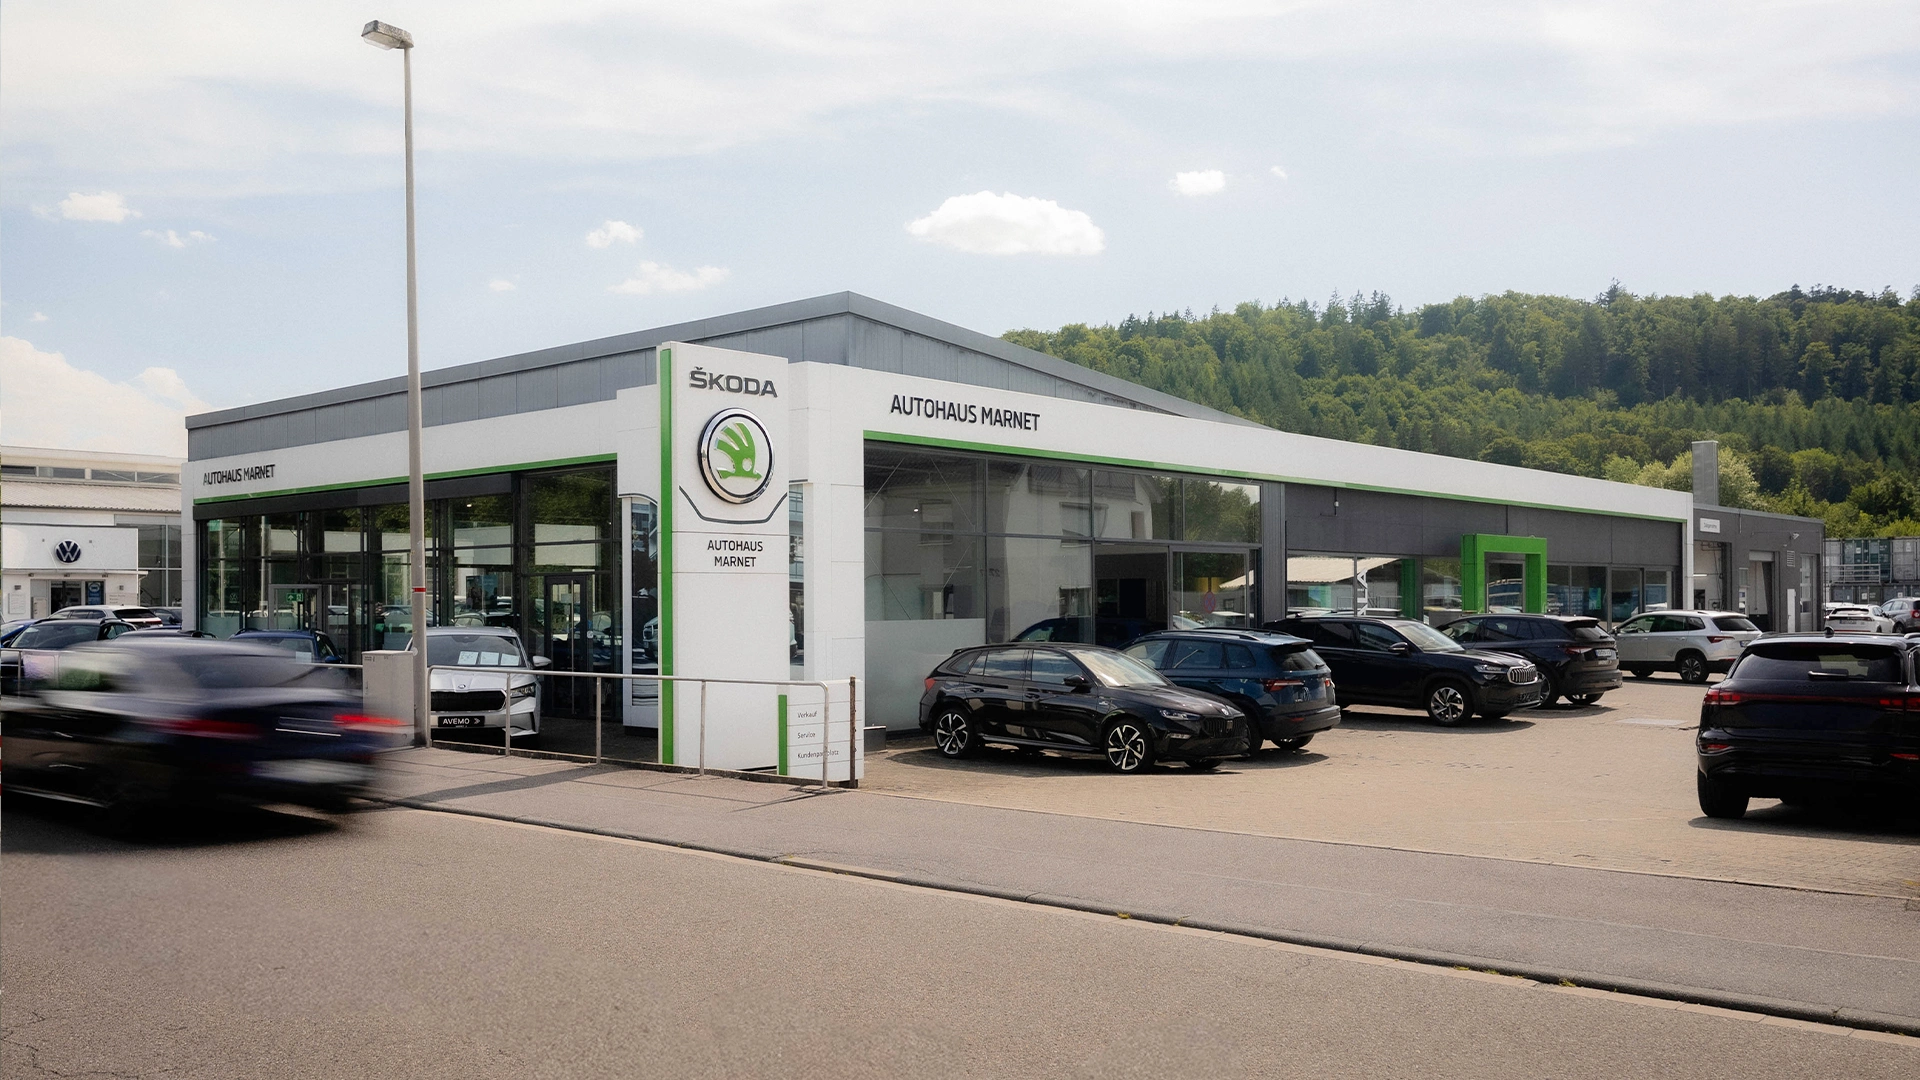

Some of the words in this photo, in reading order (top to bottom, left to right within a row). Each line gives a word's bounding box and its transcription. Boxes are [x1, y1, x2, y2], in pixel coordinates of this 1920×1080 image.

[689, 366, 778, 398] ŠKODA
[890, 394, 977, 423] AUTOHAUS
[981, 406, 1041, 431] MARNET
[203, 468, 242, 485] AUTOHAUS
[243, 464, 275, 481] MARNET
[707, 539, 764, 552] AUTOHAUS
[714, 556, 757, 567] MARNET
[797, 710, 818, 718] Verkauf
[442, 717, 470, 725] AVEMO
